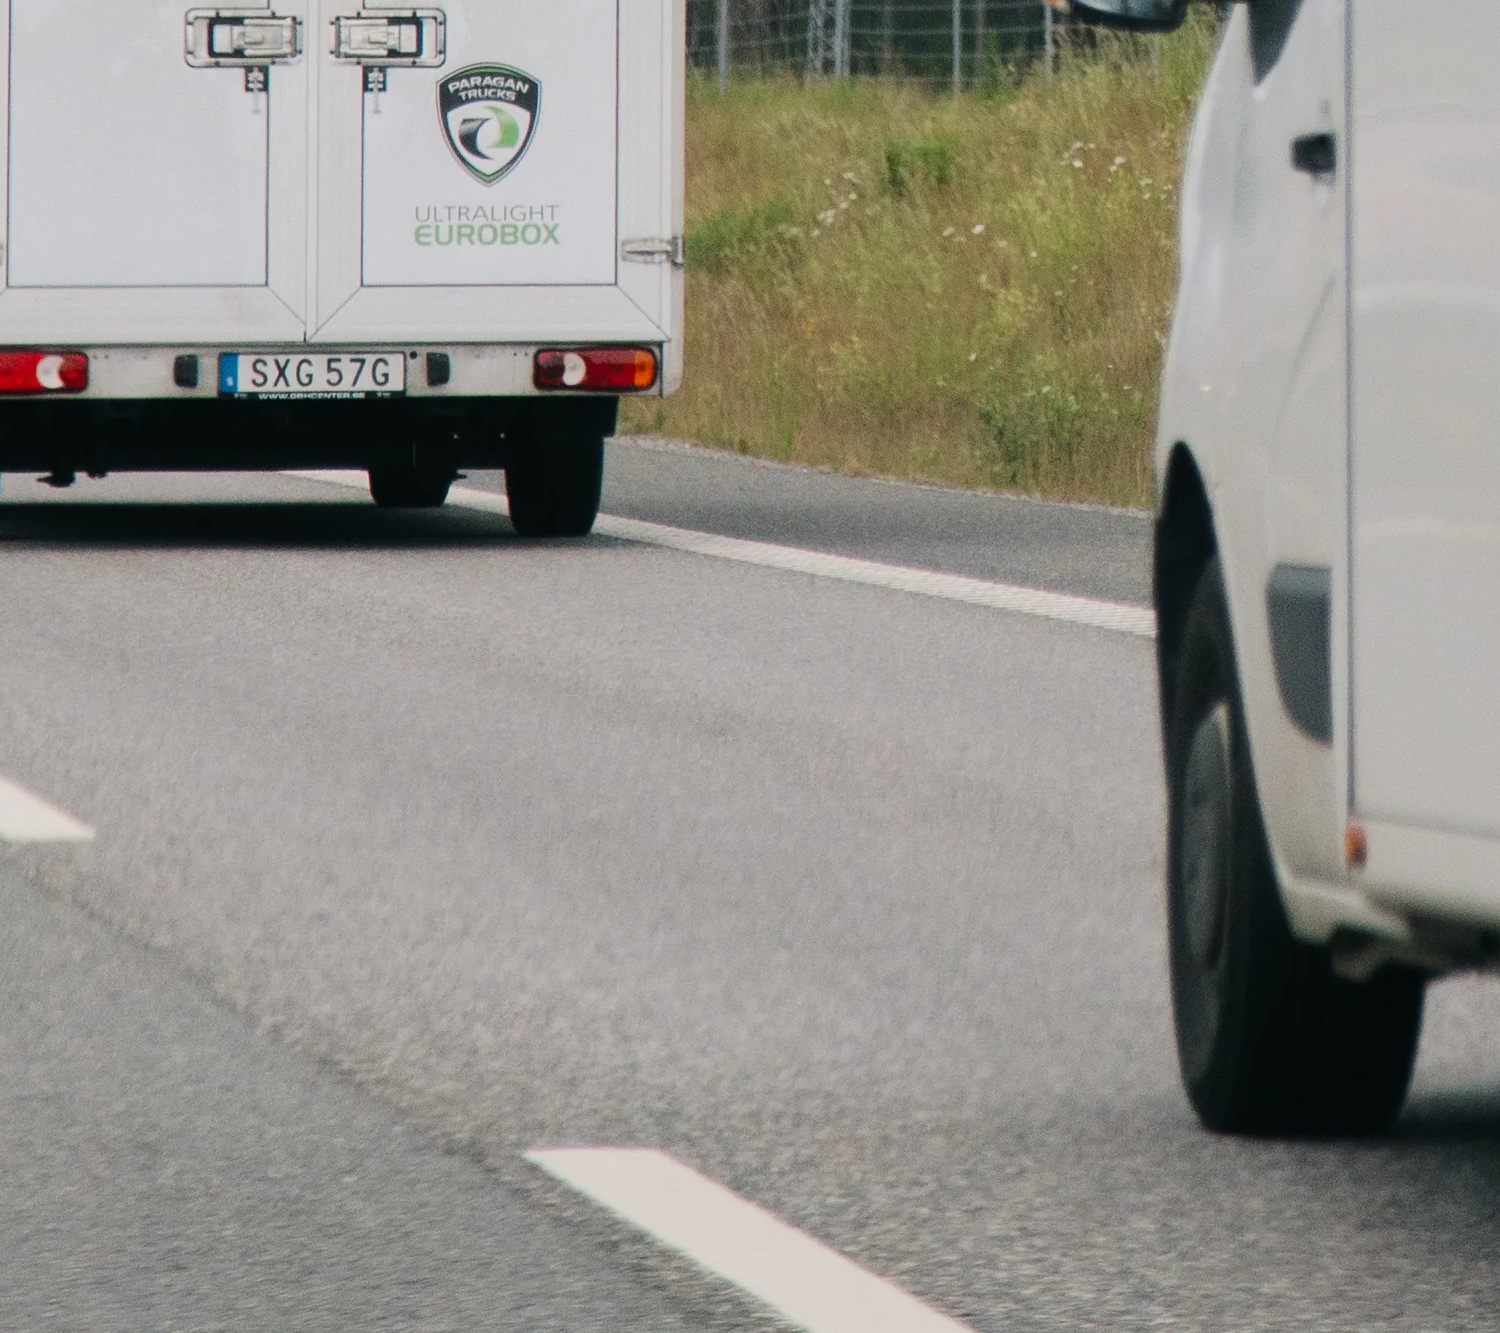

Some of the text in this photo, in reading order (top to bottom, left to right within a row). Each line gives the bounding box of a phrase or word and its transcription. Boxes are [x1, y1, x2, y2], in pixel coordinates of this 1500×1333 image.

[448, 76, 529, 94] PARAGAN
[459, 89, 517, 101] TRUCKS
[415, 205, 560, 222] ULTRALIGHT
[414, 223, 560, 246] EUROBOX
[251, 357, 390, 388] SXG 57G
